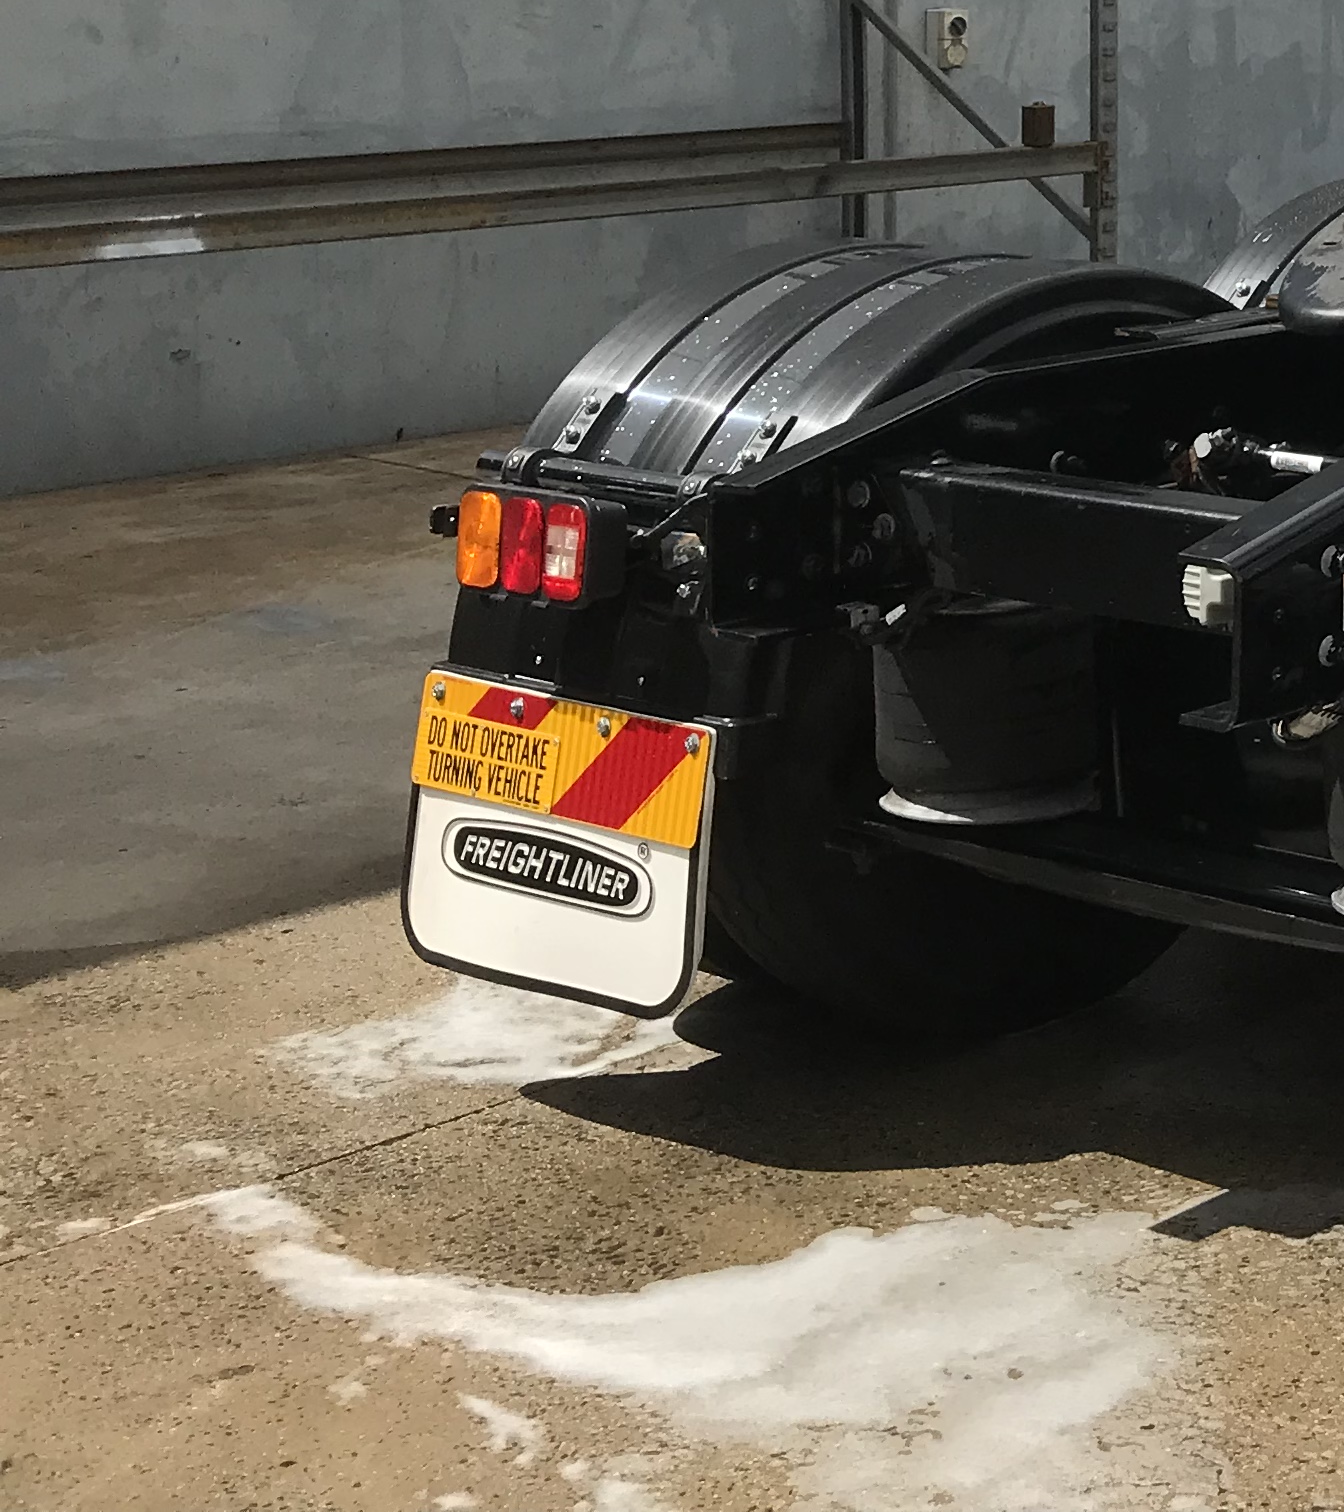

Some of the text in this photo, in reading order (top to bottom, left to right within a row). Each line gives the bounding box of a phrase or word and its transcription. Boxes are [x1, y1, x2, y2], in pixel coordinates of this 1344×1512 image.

[427, 715, 550, 771] DO NOT OVERTAKE
[427, 749, 543, 805] TURNING VEHICLE
[460, 834, 630, 901] FREIGHTLINER
